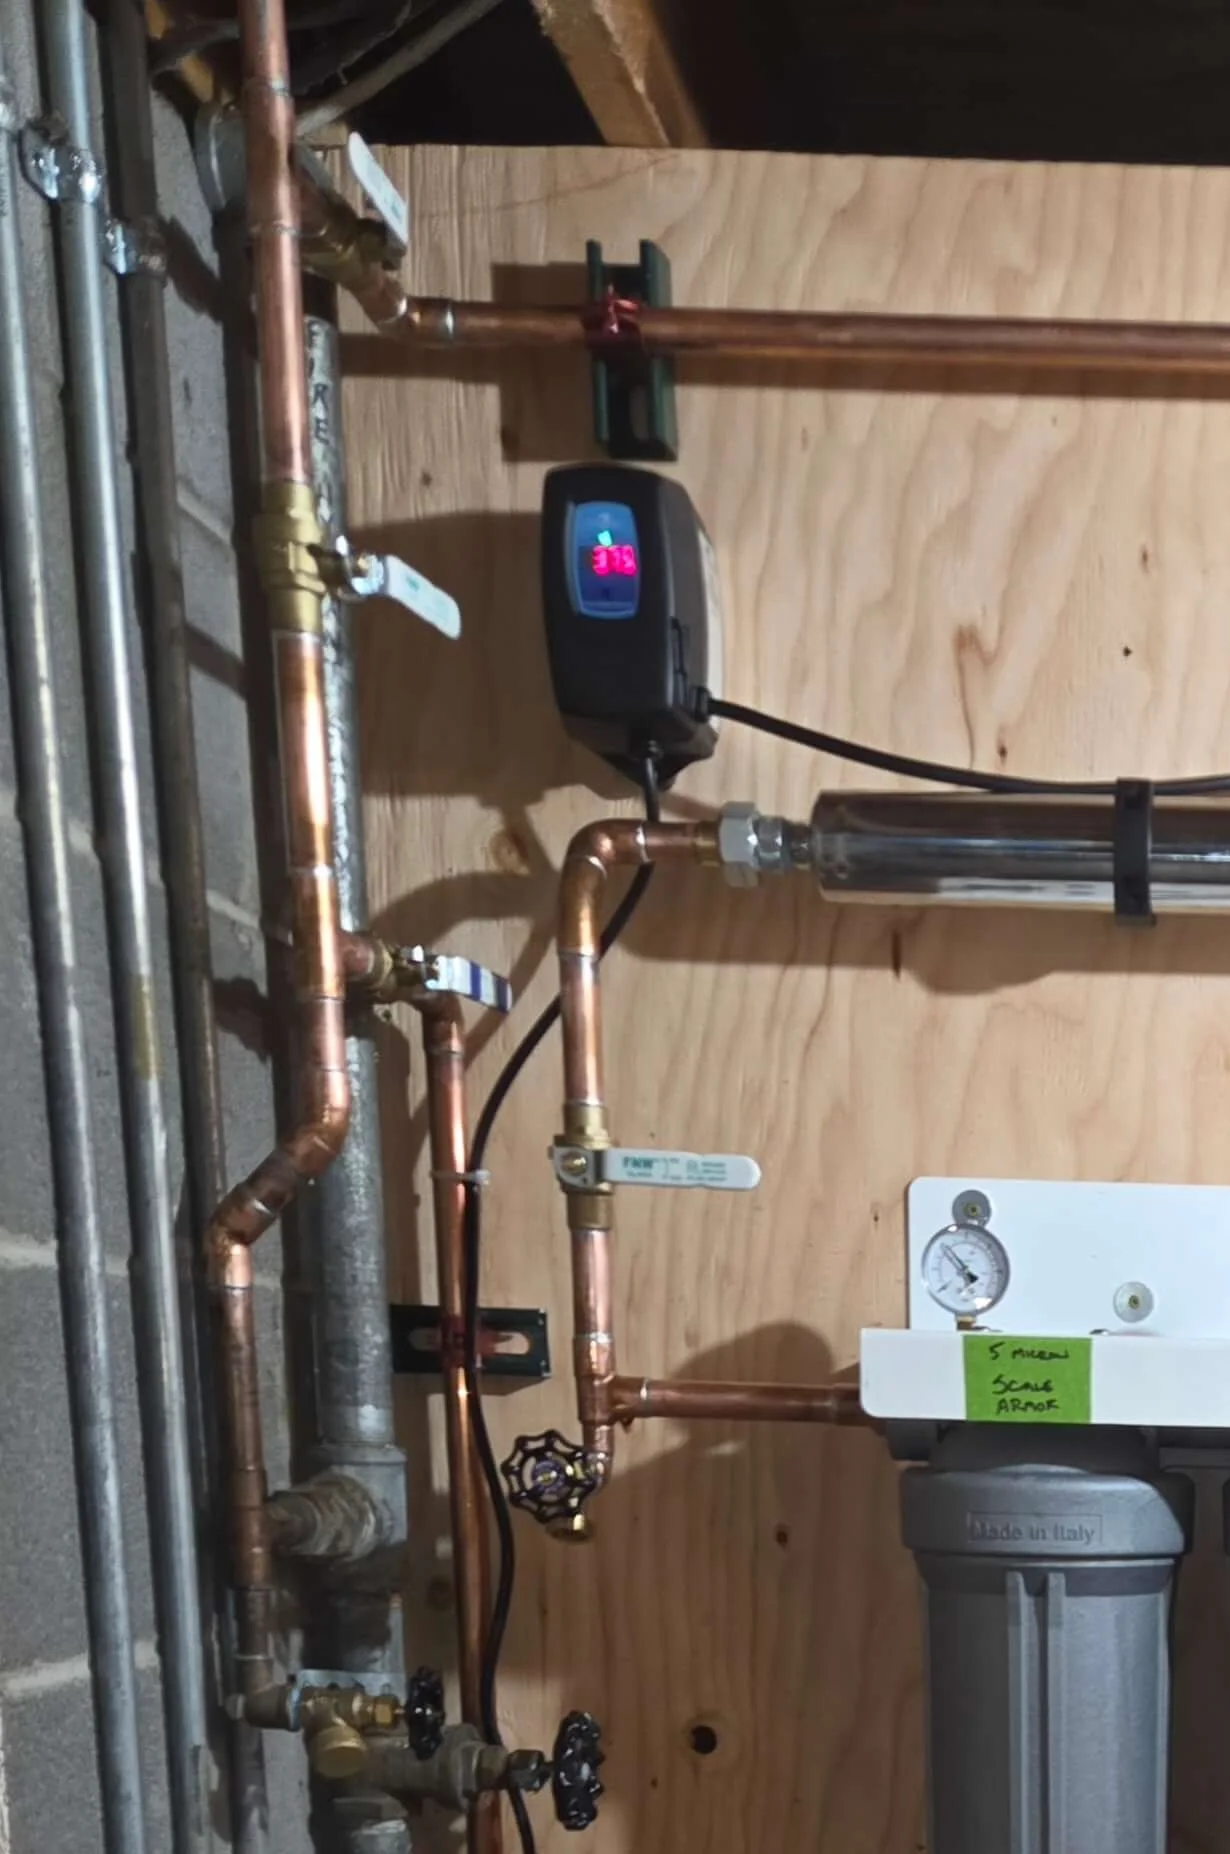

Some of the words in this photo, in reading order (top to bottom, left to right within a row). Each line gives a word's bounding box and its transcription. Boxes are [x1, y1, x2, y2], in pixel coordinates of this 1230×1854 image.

[989, 1341, 1006, 1361] 5
[973, 1520, 1024, 1541] Made
[1030, 1522, 1047, 1541] in
[1053, 1522, 1096, 1546] Italy
